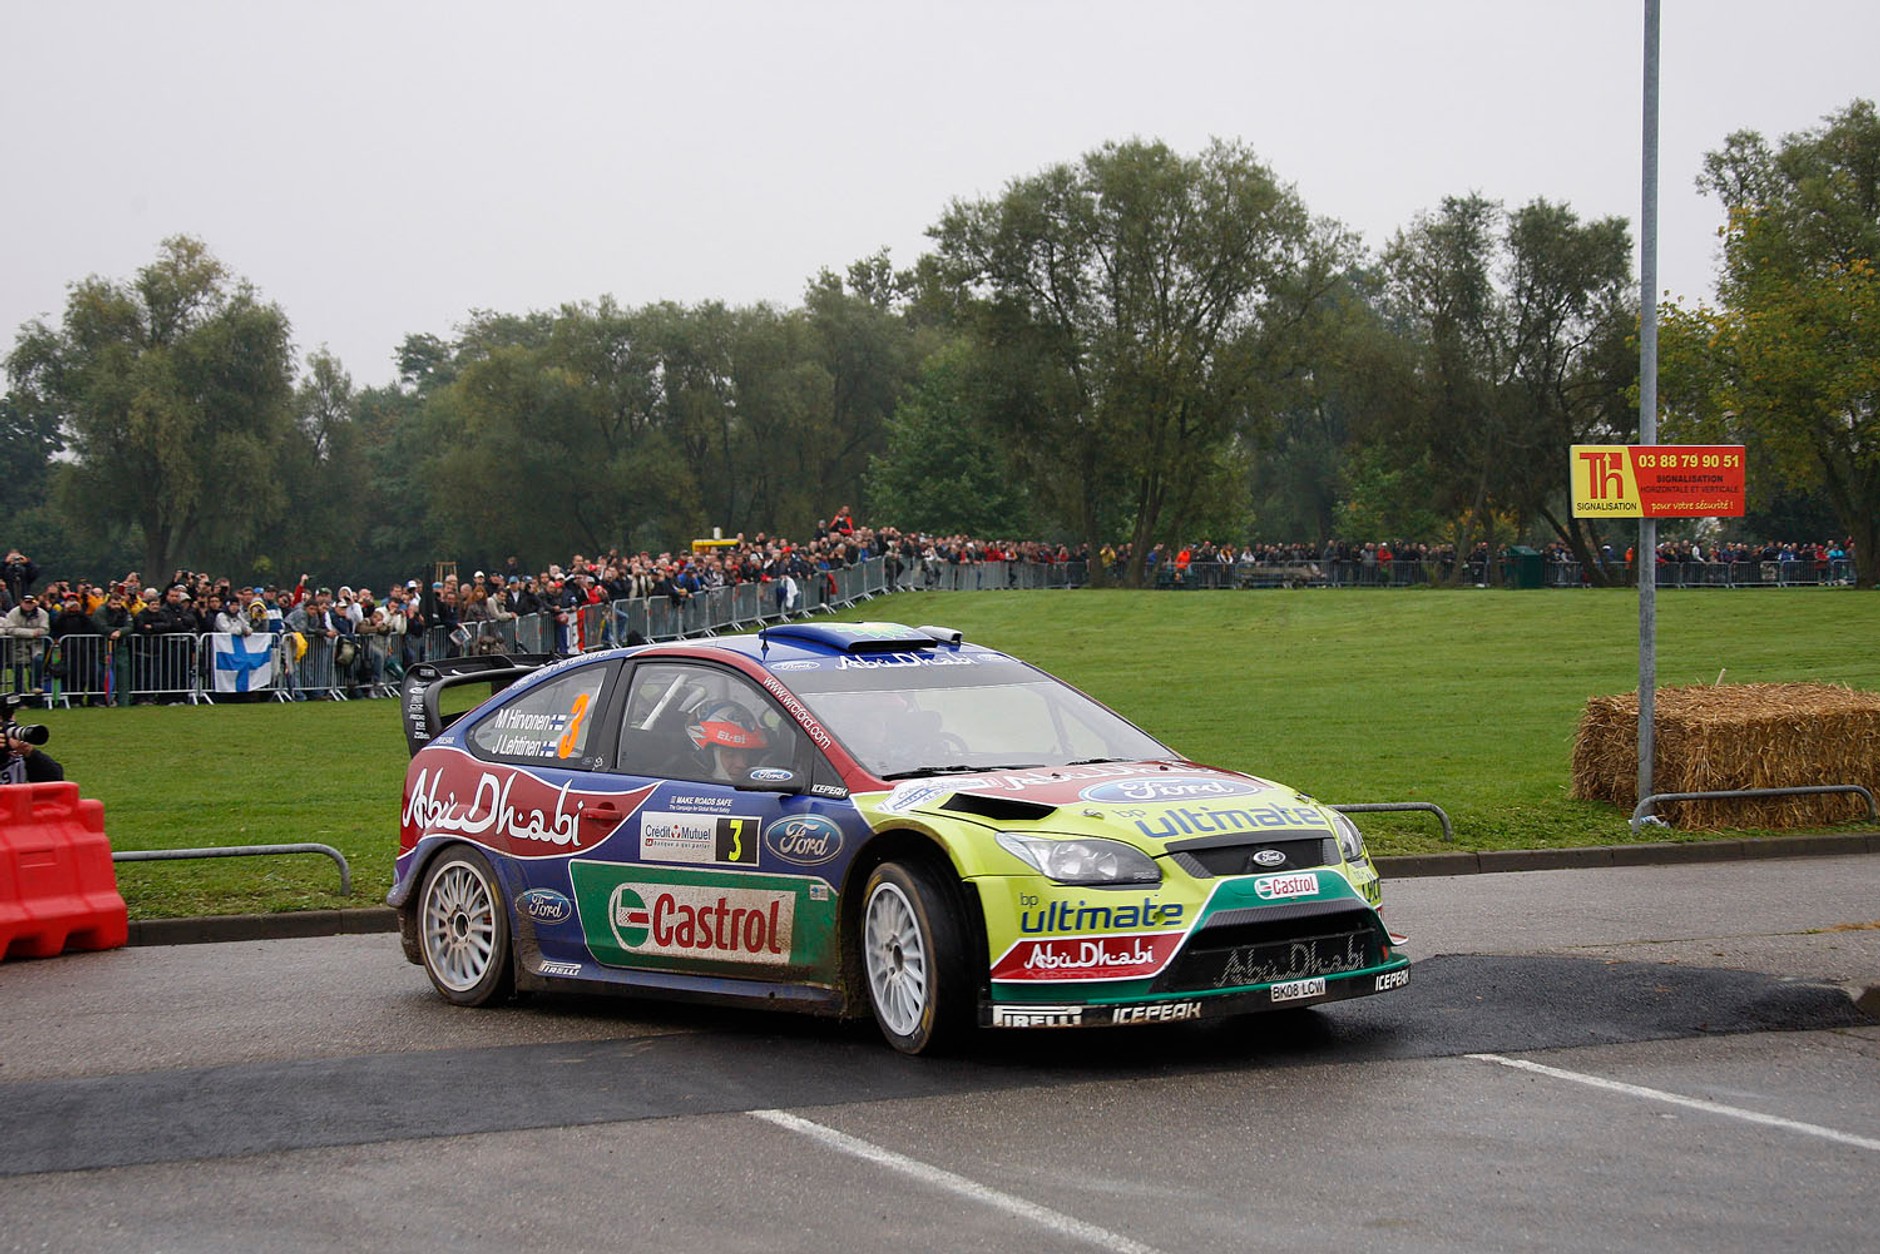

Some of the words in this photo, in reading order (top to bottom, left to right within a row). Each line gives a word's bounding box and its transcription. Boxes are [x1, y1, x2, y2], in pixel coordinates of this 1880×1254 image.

[1638, 454, 1656, 468] 03
[1660, 454, 1677, 468] 88
[1681, 454, 1699, 468] 79
[1702, 454, 1720, 468] 90
[1723, 454, 1739, 468] 51
[1579, 452, 1623, 499] Th
[1656, 475, 1724, 483] SIGNALISATION
[1576, 502, 1637, 511] SIGNALISATION
[1651, 503, 1671, 514] pour
[1673, 502, 1693, 510] votre
[1695, 500, 1729, 510] sécurité
[835, 654, 891, 670] Abu
[891, 651, 977, 668] Dhabi
[495, 709, 507, 729] M
[505, 709, 550, 731] Hirvonen
[763, 676, 831, 750] www.wrcford.com
[558, 693, 591, 760] 3
[491, 735, 503, 754] J
[501, 735, 542, 757] Lehtinen
[758, 771, 786, 780] Ford
[811, 784, 848, 796] ICEPEAK
[1117, 780, 1235, 800] Ford
[402, 767, 464, 830] Abu
[462, 771, 584, 847] Dhabi
[676, 796, 694, 804] MAKE
[695, 797, 716, 805] ROADS
[716, 799, 734, 807] SAFE
[1113, 808, 1147, 819] bp
[1135, 802, 1326, 839] ultimate
[645, 824, 672, 838] Crédit
[681, 827, 711, 840] Mutuel
[728, 819, 743, 861] 3
[780, 821, 830, 856] Ford
[1272, 876, 1316, 895] Castrol
[529, 893, 563, 918] Ford
[1020, 892, 1039, 908] bp
[653, 893, 781, 954] Castrol
[1021, 897, 1184, 933] ultimate
[1023, 943, 1081, 969] Abu
[1080, 938, 1155, 968] Dhabi
[1213, 949, 1289, 988] Abu
[1288, 934, 1365, 977] Dhabi
[538, 960, 582, 976] PIRELLI
[1273, 985, 1300, 1000] BK08
[1302, 981, 1325, 996] LCW
[1375, 969, 1410, 992] ICEPEAK
[992, 1005, 1083, 1027] PIRELLI
[1112, 1002, 1202, 1024] ICEPEAK
